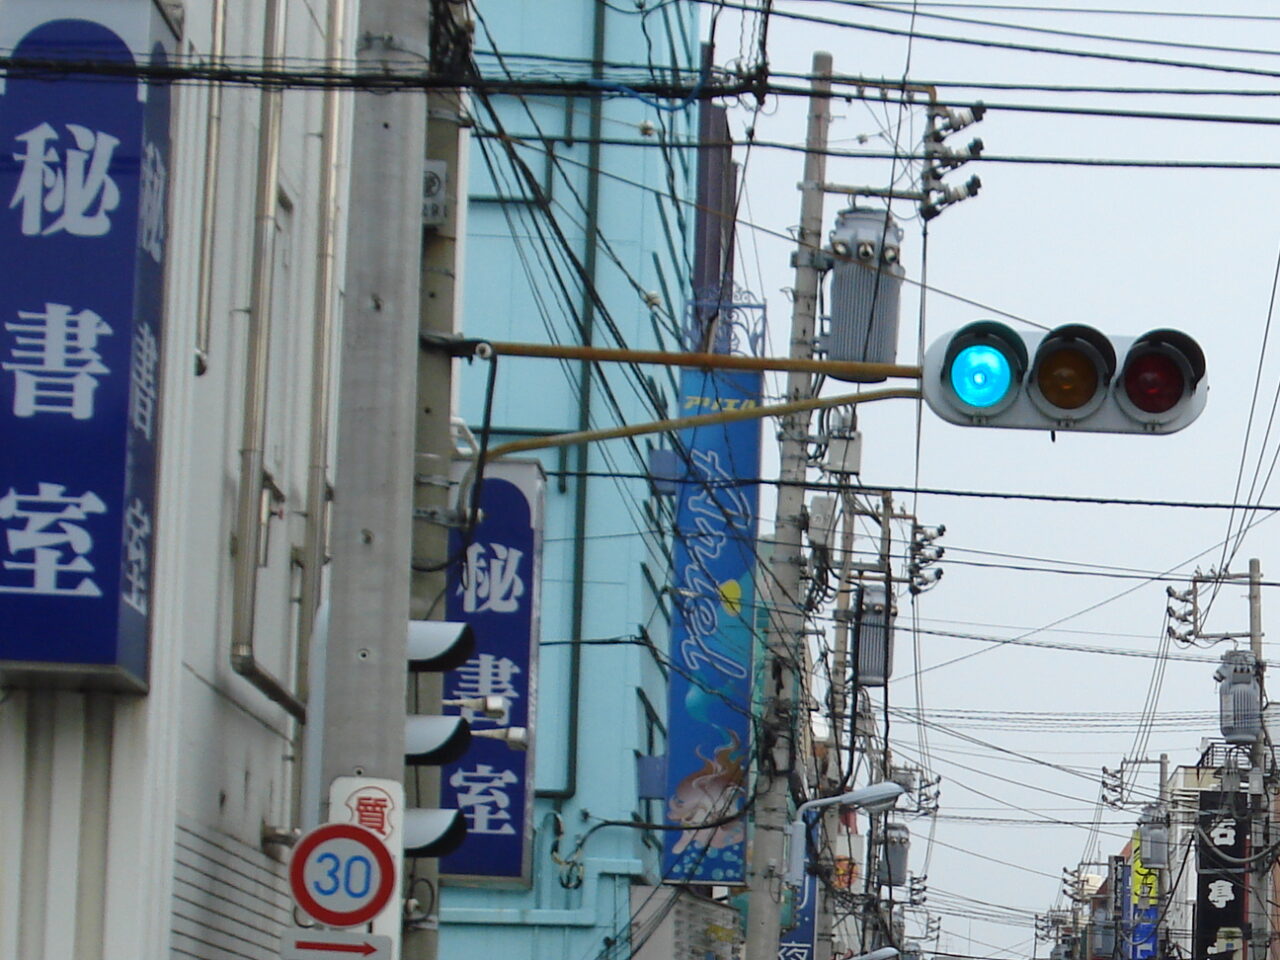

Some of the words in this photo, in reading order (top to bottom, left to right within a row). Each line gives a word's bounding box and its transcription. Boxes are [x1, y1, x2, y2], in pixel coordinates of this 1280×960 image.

[0, 122, 120, 597] 秘書室
[448, 542, 524, 836] 秘書室
[313, 852, 373, 899] 30
[355, 796, 388, 837] 質
